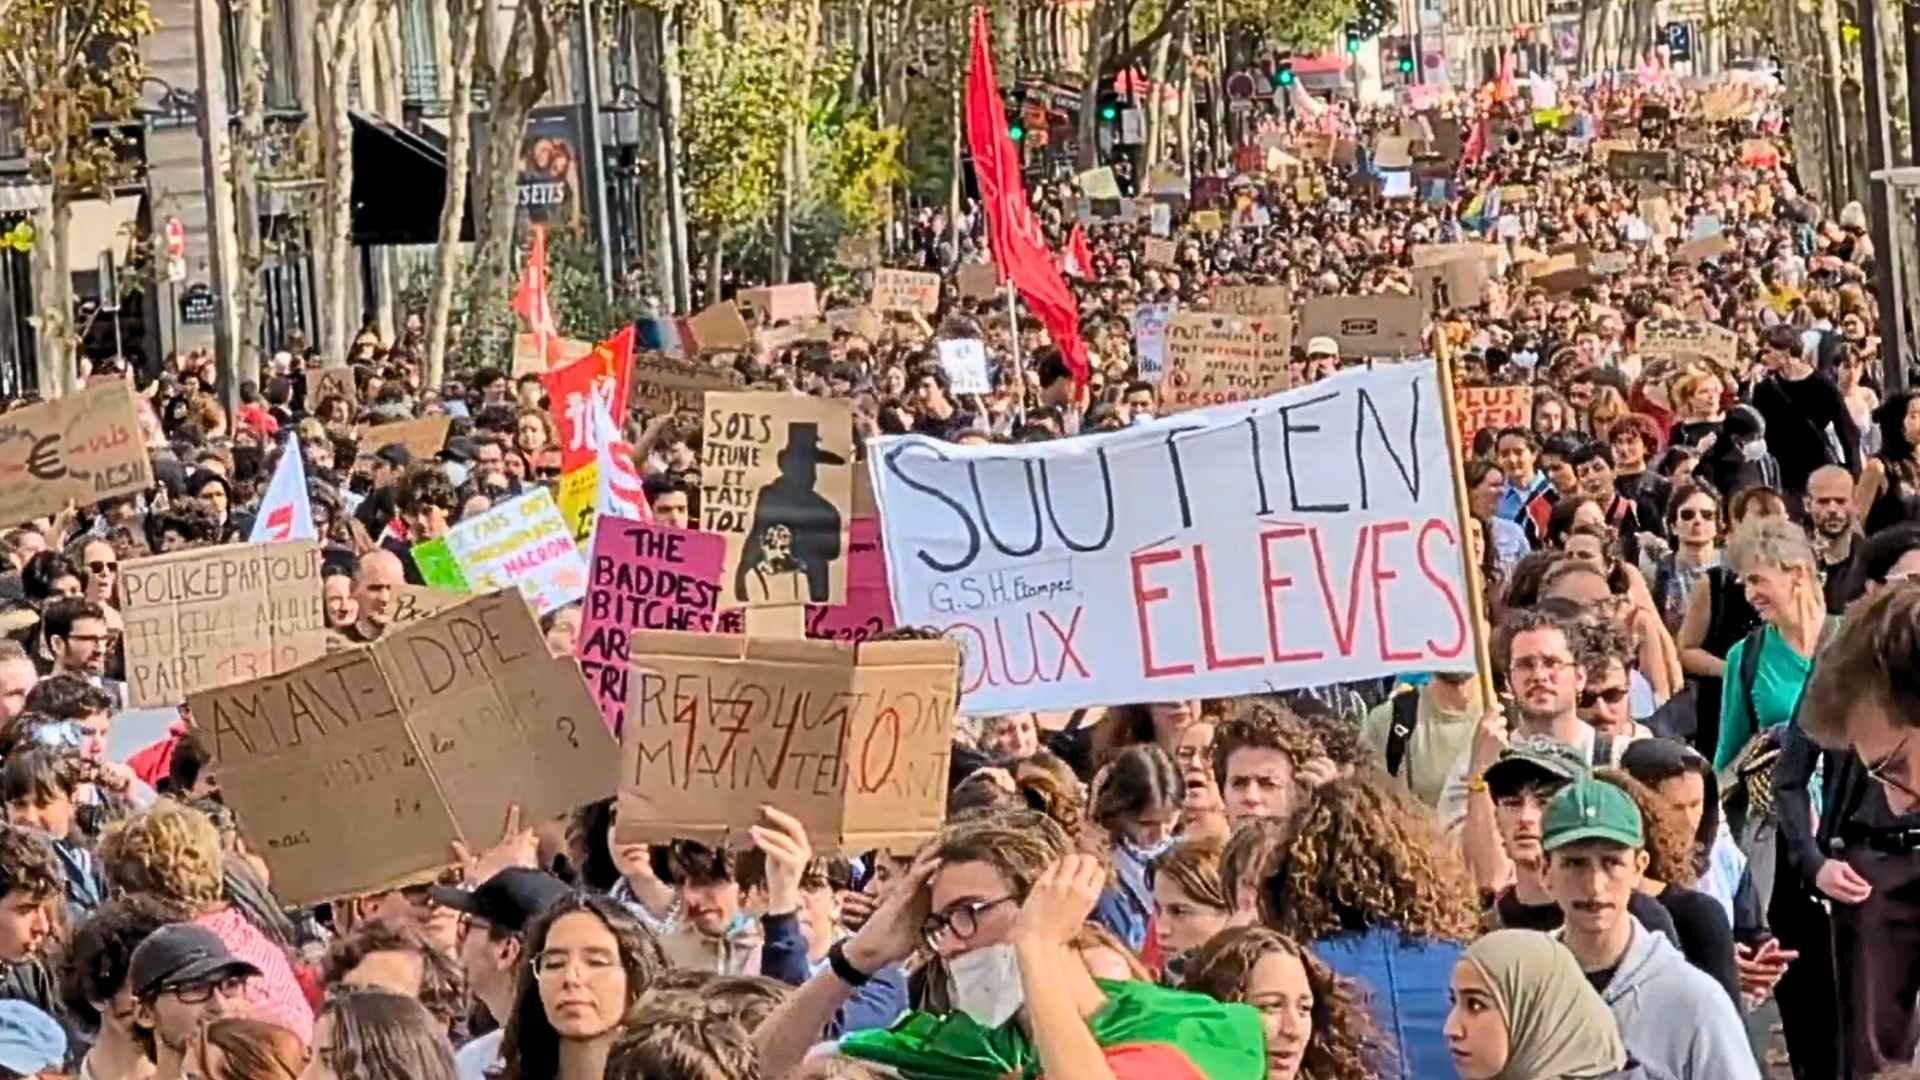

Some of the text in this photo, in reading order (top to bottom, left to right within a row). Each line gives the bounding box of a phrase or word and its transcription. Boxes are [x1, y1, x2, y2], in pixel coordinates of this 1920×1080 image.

[1226, 375, 1275, 388] TOUT
[709, 409, 772, 444] SOIS
[703, 443, 761, 468] JEUNE
[723, 470, 746, 486] ET
[884, 377, 1422, 573] SOUTIEN
[703, 486, 754, 509] TAIS
[705, 507, 748, 533] TOI
[624, 528, 686, 563] THE
[123, 550, 320, 606] POLICE PARTOUT
[595, 556, 723, 613] BADDEST
[592, 590, 713, 632] BITCHES
[1130, 518, 1468, 680] ÉLÈVES
[584, 627, 631, 661] AR
[134, 654, 206, 701] PART
